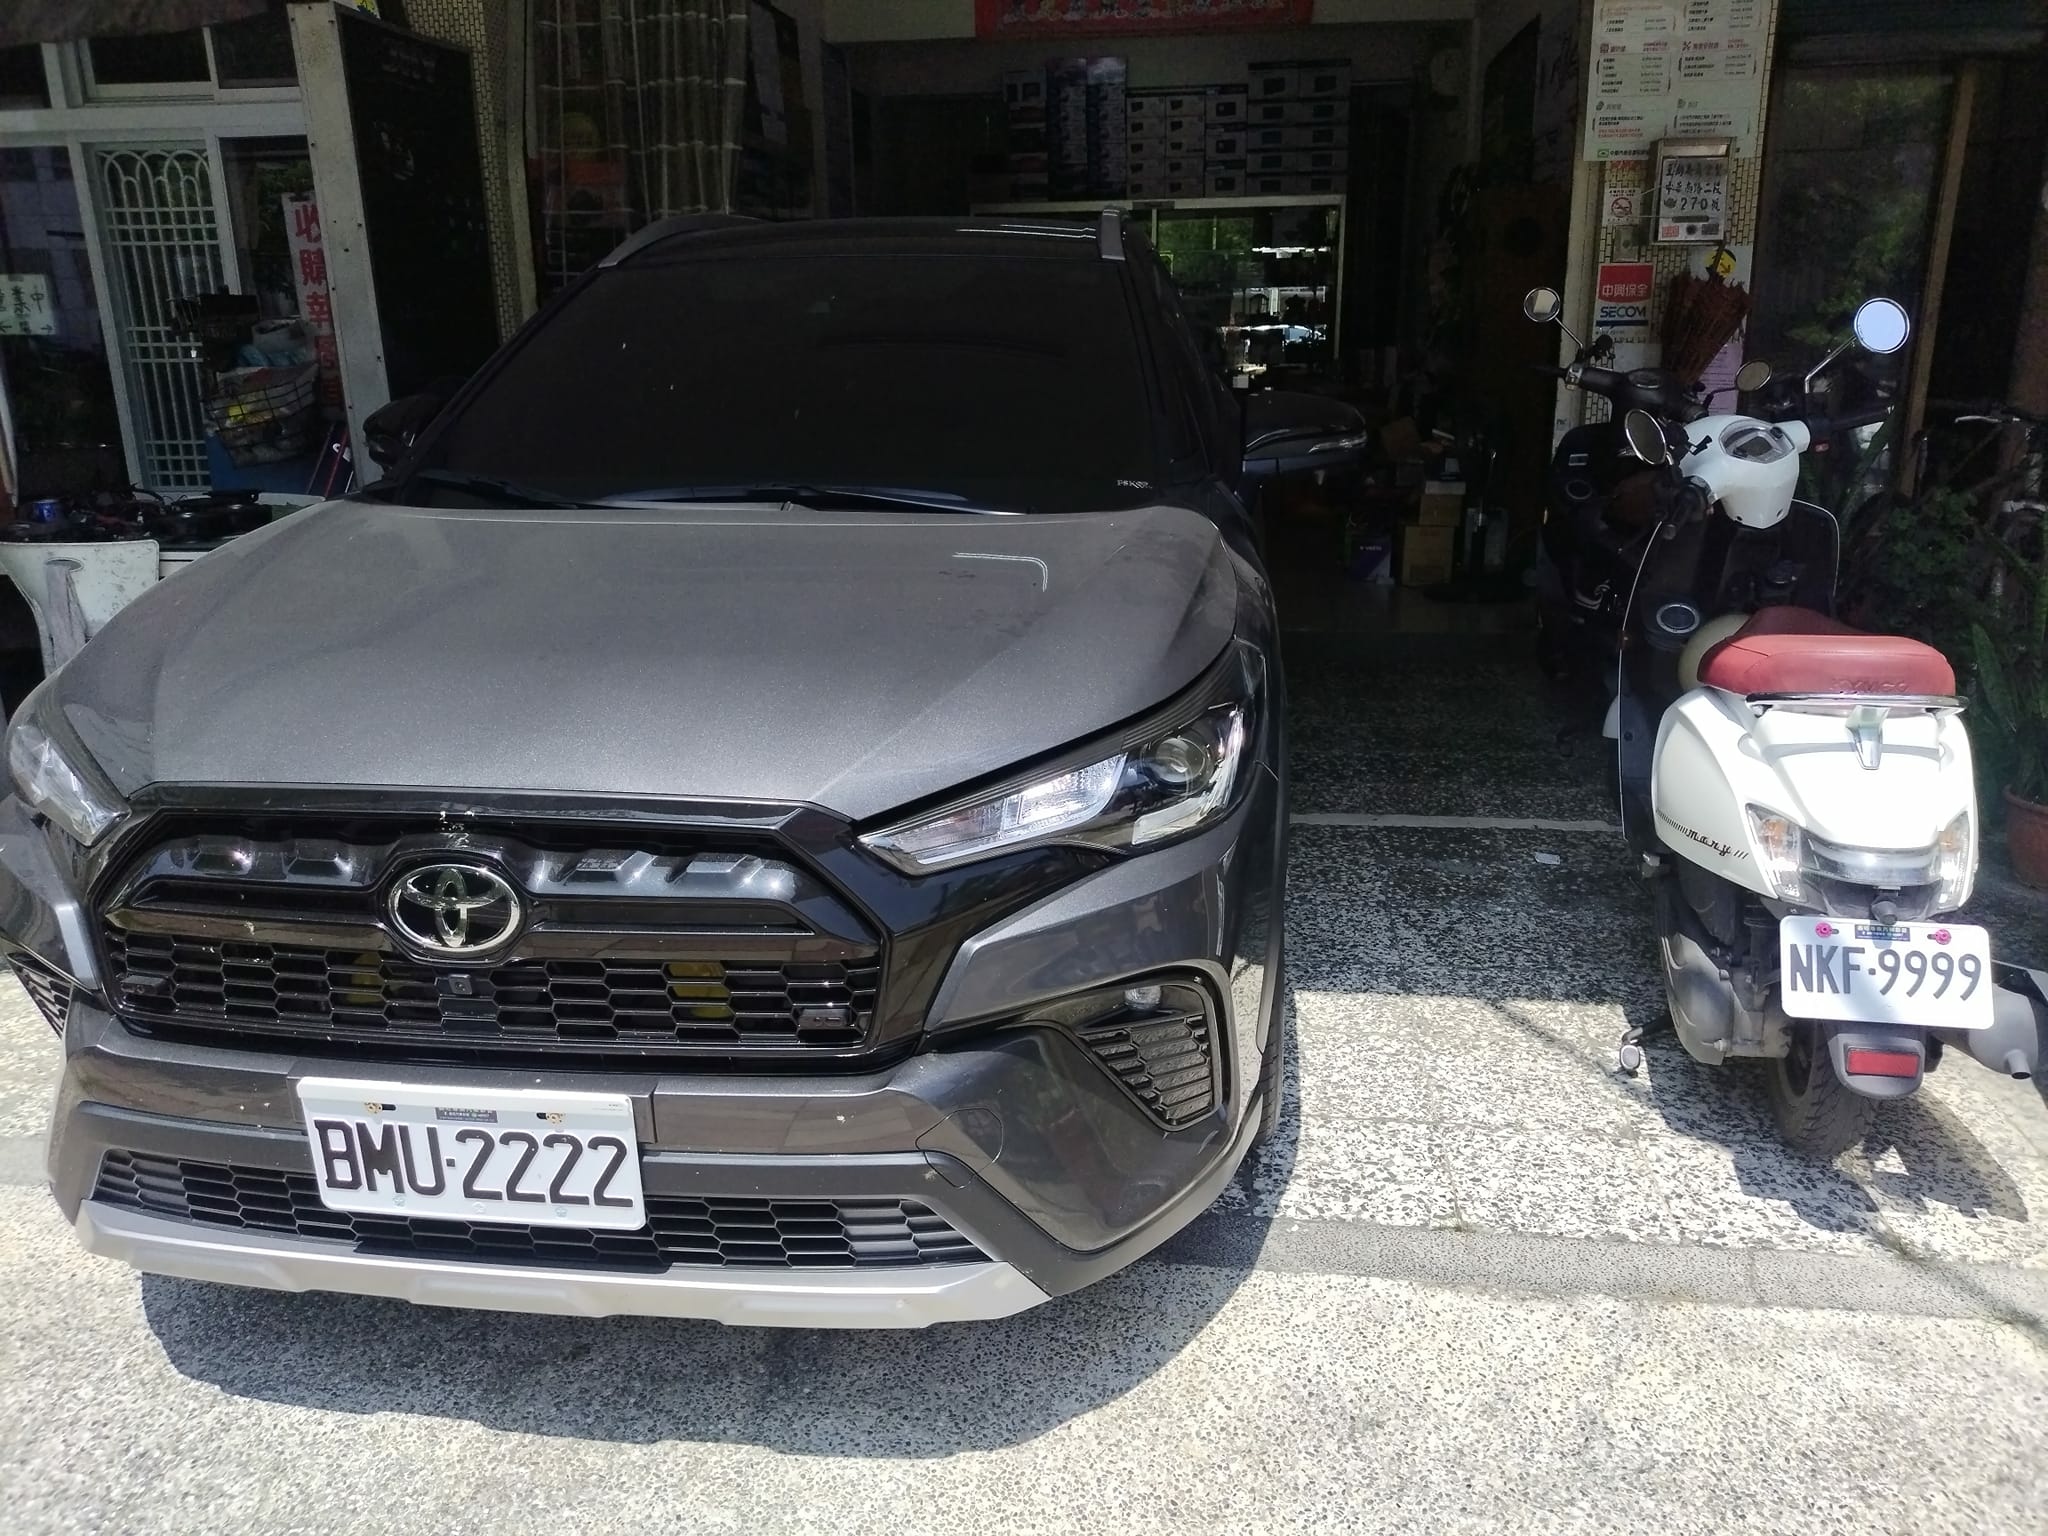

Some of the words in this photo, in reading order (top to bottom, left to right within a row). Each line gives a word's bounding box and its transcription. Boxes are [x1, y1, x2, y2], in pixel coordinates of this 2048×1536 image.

[1602, 283, 1648, 298] 中興保全
[1600, 306, 1646, 318] SECOM
